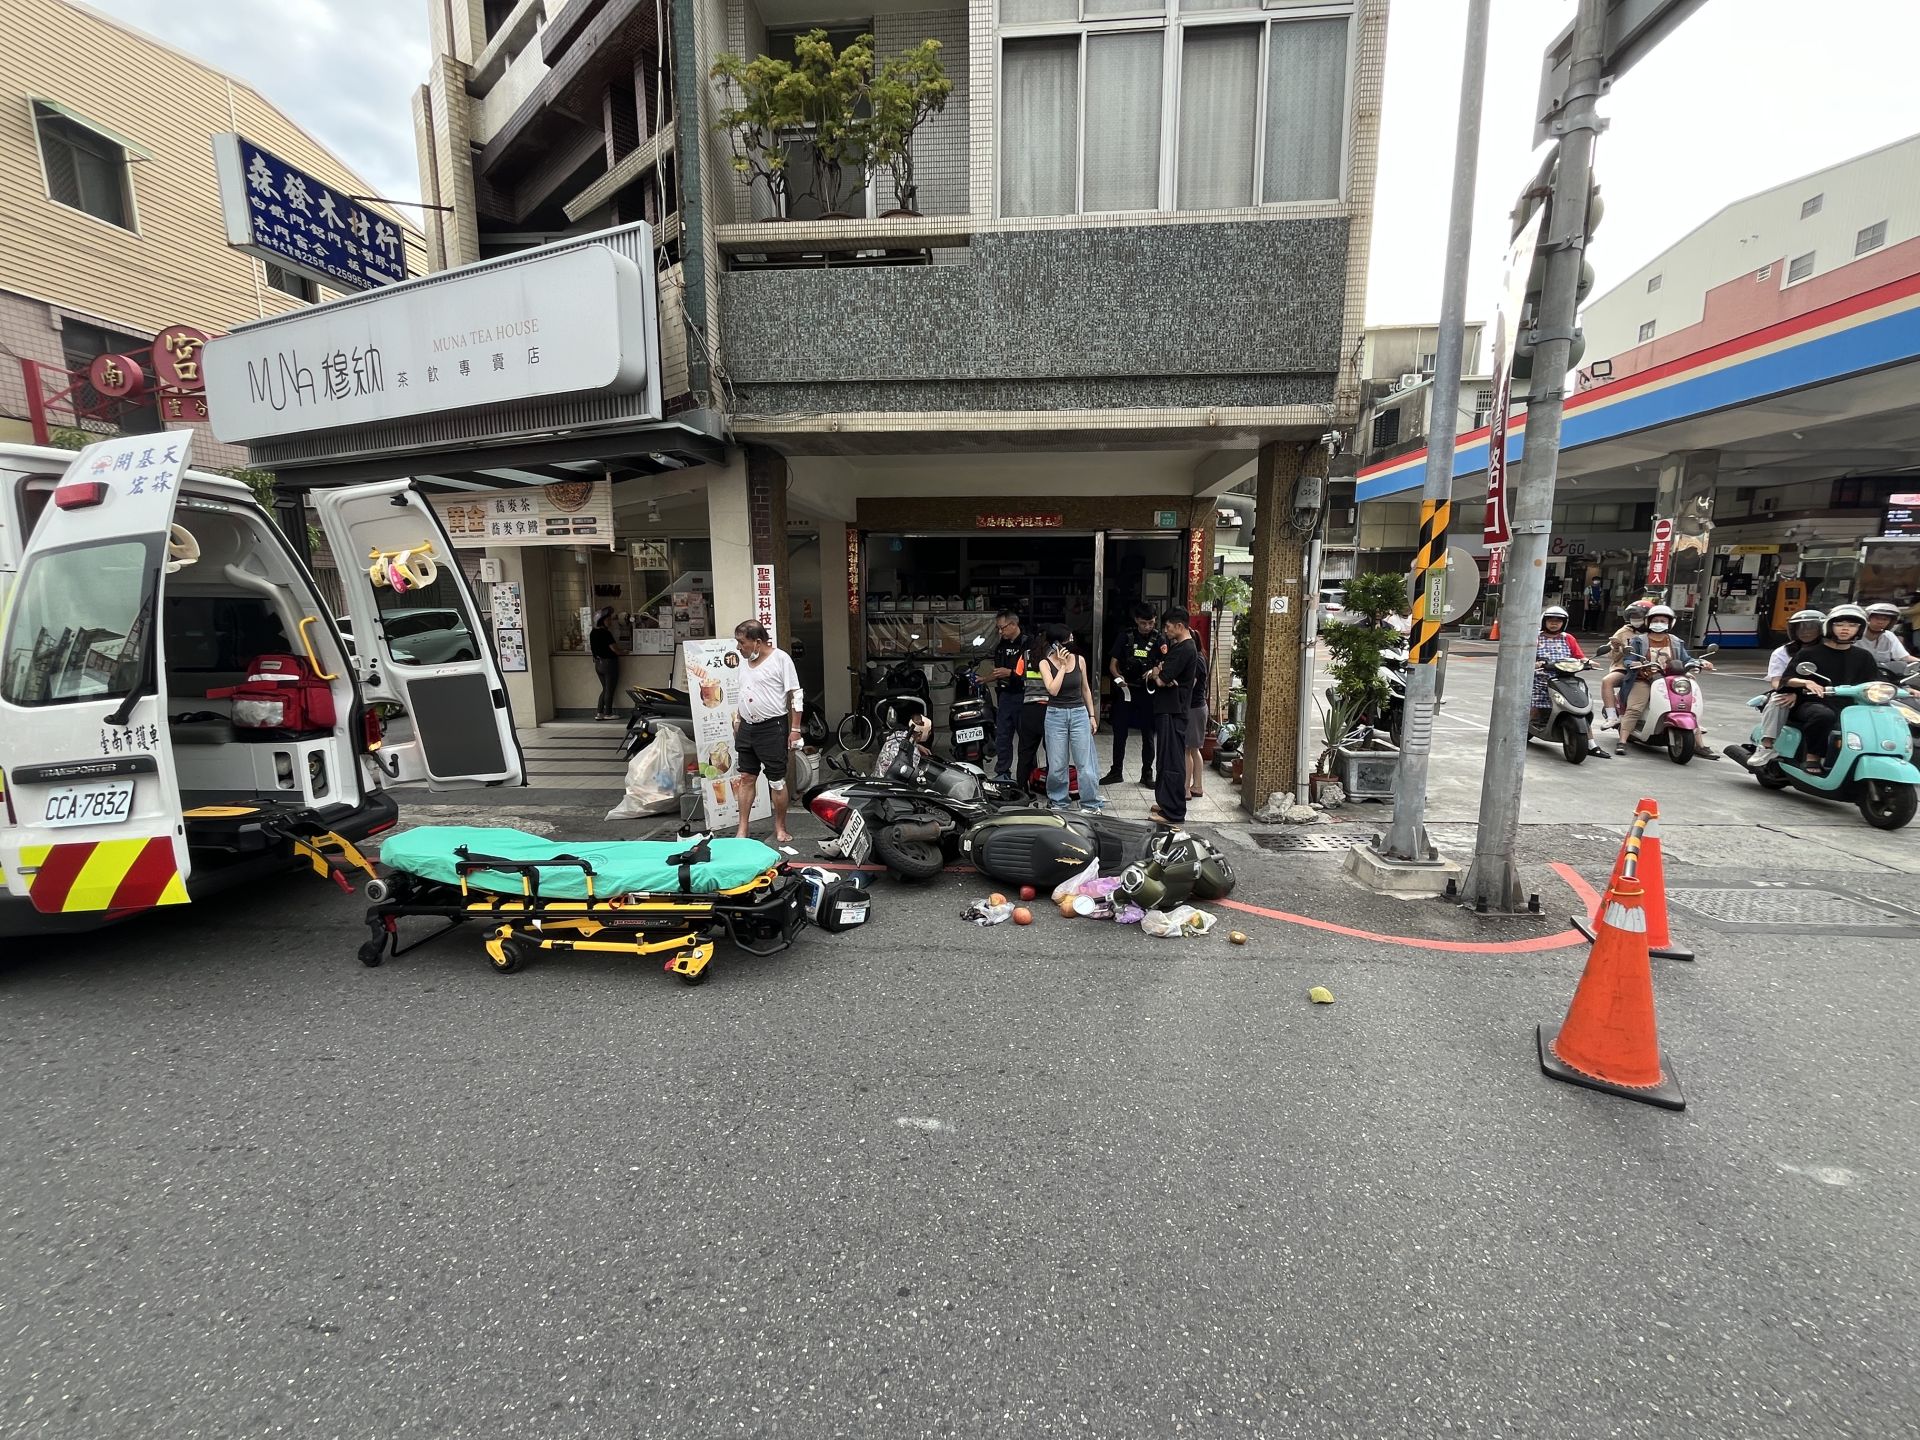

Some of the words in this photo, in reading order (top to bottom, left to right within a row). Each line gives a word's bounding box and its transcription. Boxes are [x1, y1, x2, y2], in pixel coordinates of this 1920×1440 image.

[433, 335, 467, 353] MUNA
[469, 328, 493, 346] TEA
[496, 318, 540, 338] HOUSE
[397, 346, 540, 388] 茶飲專賣店
[1568, 543, 1585, 555] GO
[1652, 542, 1666, 584] 禁止進入
[1432, 578, 1441, 615] 210696
[38, 763, 117, 778] TRANSPORTER
[45, 790, 129, 821] CCA-7832
